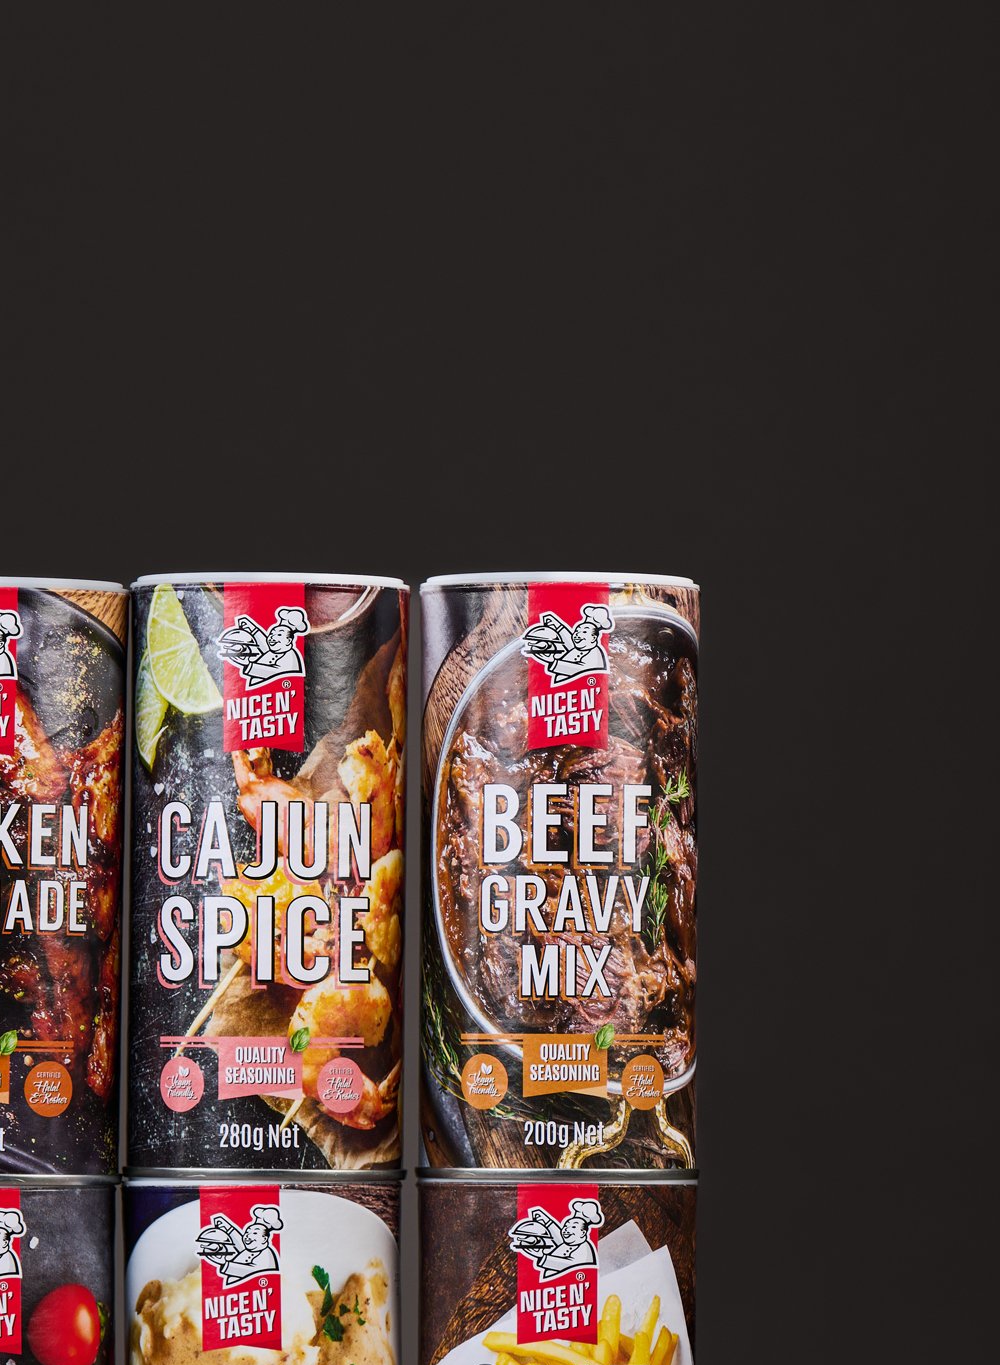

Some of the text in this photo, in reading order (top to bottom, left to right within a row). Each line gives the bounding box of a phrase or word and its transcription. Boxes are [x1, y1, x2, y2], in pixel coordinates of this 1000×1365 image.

[531, 688, 601, 717] NICE N'
[544, 710, 603, 738] TASTY
[483, 784, 652, 864] BEEF
[161, 801, 372, 880] CAJUN
[481, 875, 650, 933] GRAVY
[160, 896, 370, 983] SPICE
[521, 945, 612, 997] MIX
[235, 1047, 286, 1064] QUALITY
[540, 1044, 591, 1062] QUALITY
[225, 1067, 295, 1085] SEASONING
[530, 1064, 600, 1081] SEASONING
[219, 1123, 299, 1150] 280g Net
[524, 1121, 604, 1148] 200g Net
[521, 1282, 590, 1312] NICE N'
[533, 1305, 592, 1333] TASTY
